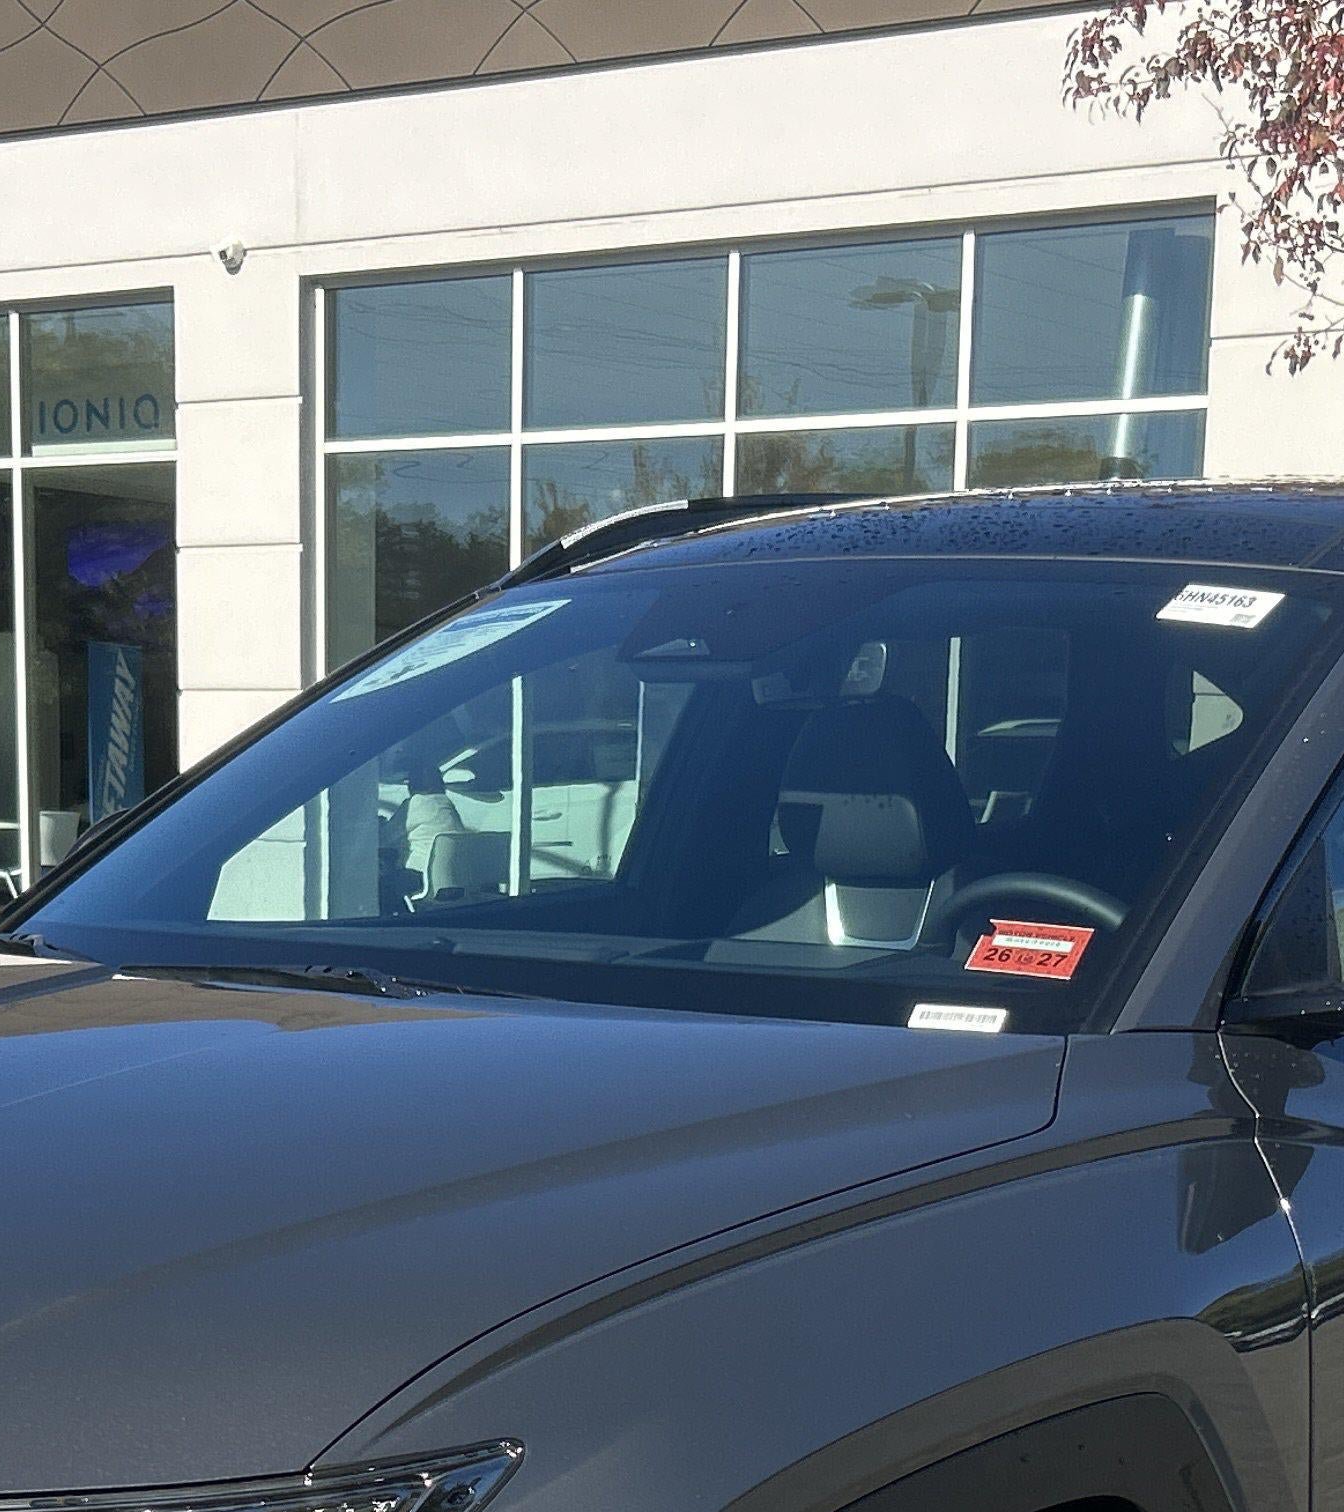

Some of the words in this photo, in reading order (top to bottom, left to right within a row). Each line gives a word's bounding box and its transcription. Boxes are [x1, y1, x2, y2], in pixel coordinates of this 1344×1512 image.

[39, 393, 160, 434] IONIQ
[983, 948, 1012, 962] 26
[1036, 953, 1068, 967] 27
